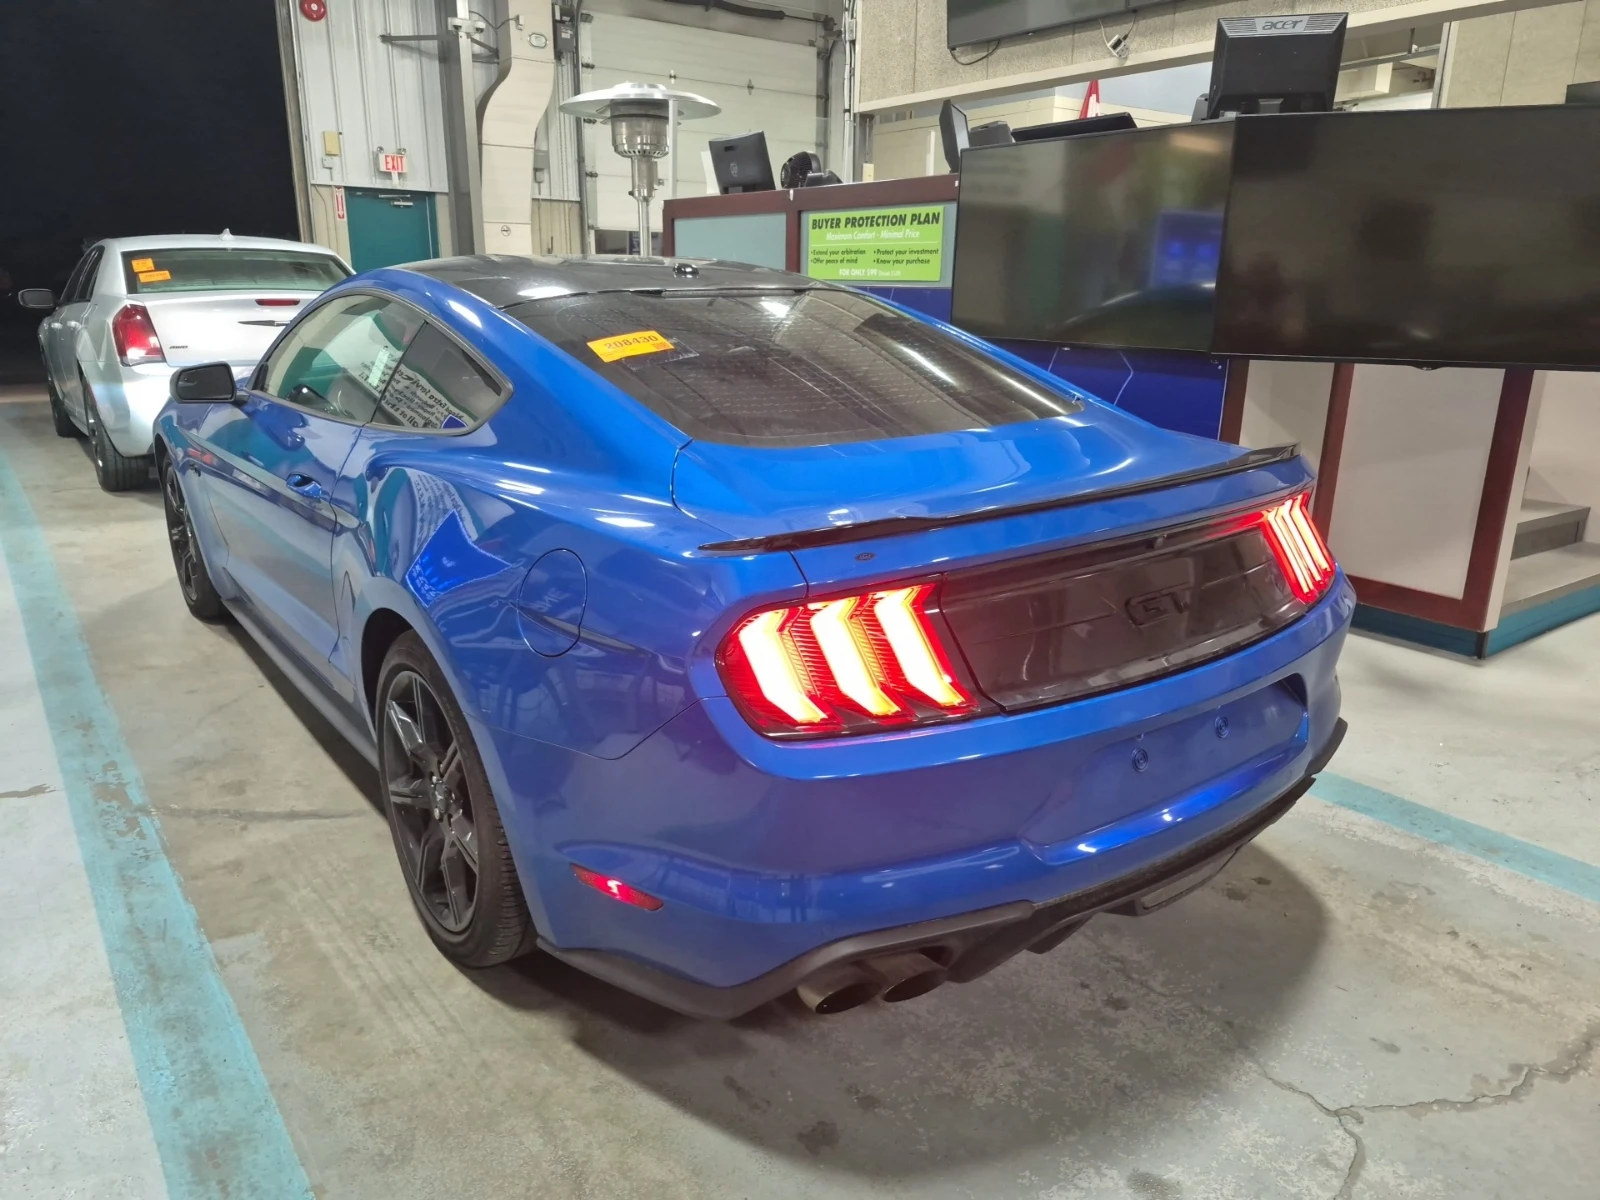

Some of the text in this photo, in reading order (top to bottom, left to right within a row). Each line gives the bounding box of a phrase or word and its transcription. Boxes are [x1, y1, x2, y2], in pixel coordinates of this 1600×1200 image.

[1262, 19, 1303, 31] acer
[385, 155, 404, 171] EXIT
[811, 212, 940, 230] BUYER PROTECTION PLAN
[904, 228, 920, 238] Price
[892, 258, 905, 266] your
[905, 257, 931, 266] purchase
[604, 334, 659, 351] 208430
